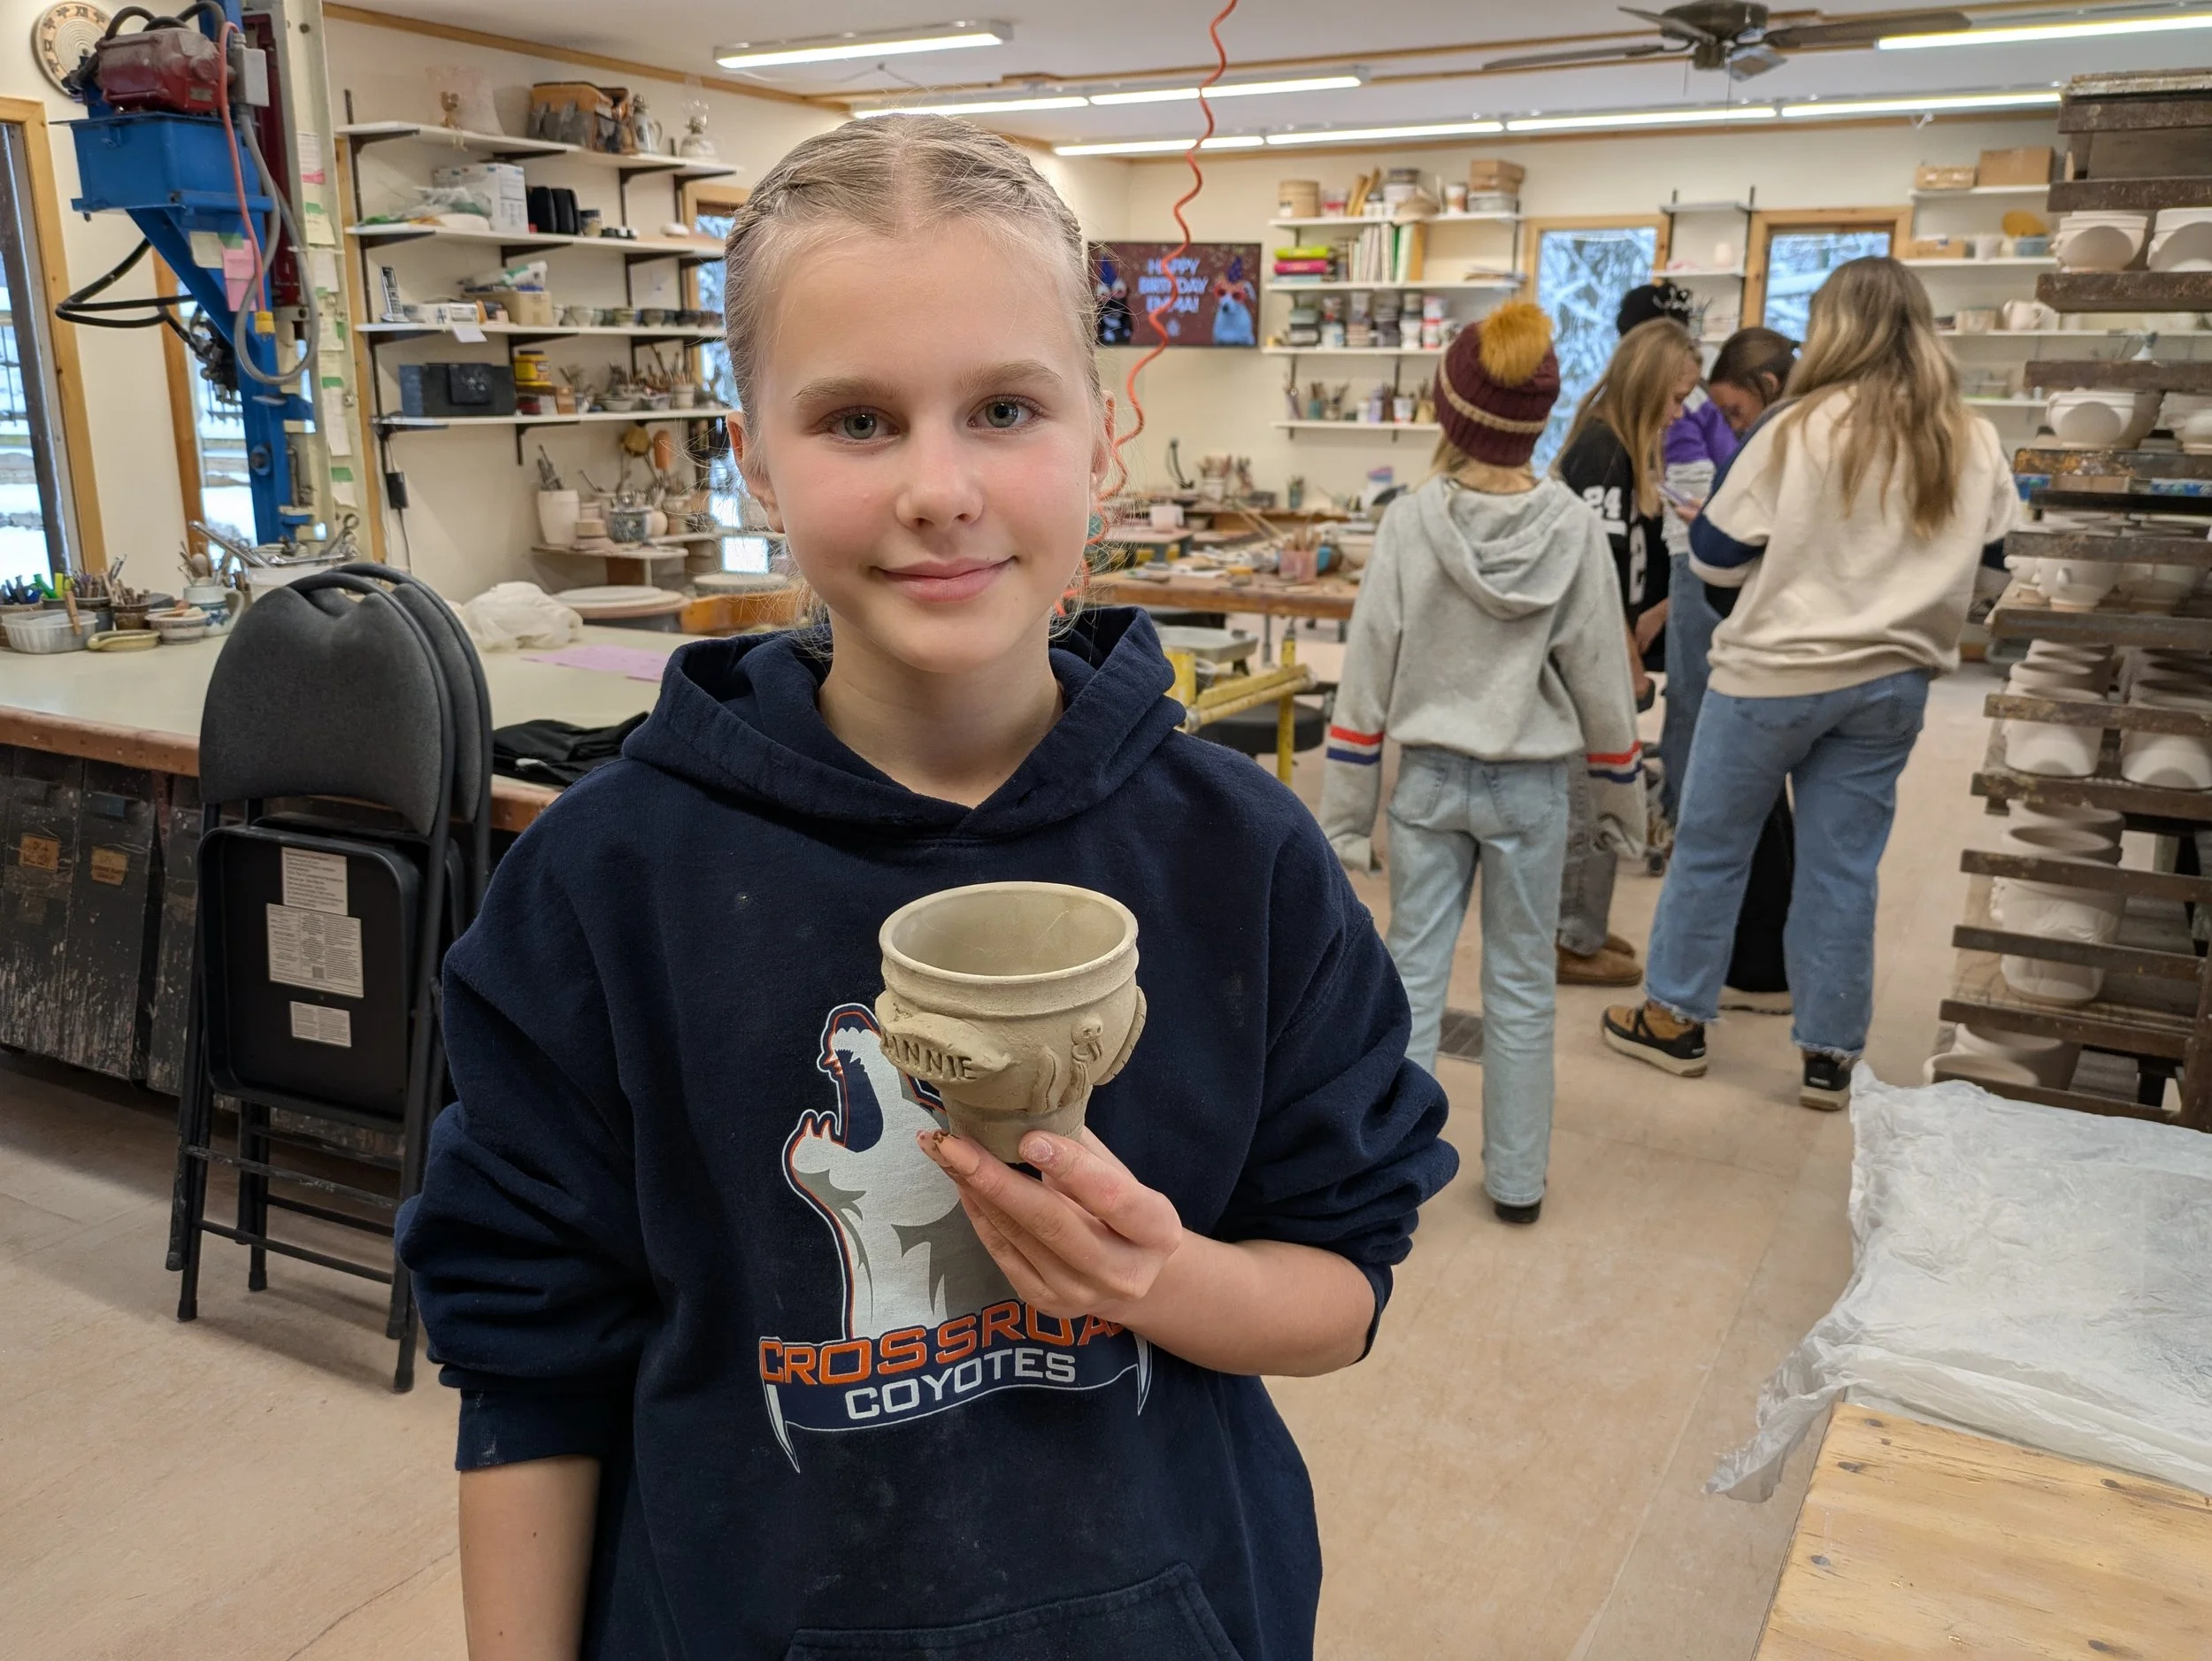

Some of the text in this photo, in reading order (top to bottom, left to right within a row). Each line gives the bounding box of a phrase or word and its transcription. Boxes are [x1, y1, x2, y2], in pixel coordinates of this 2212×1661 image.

[1138, 276, 1209, 295] BIRTDAY
[1147, 257, 1201, 275] HPPY
[760, 1301, 1124, 1386] CROSSROA
[844, 1347, 1077, 1420] COYOTES
